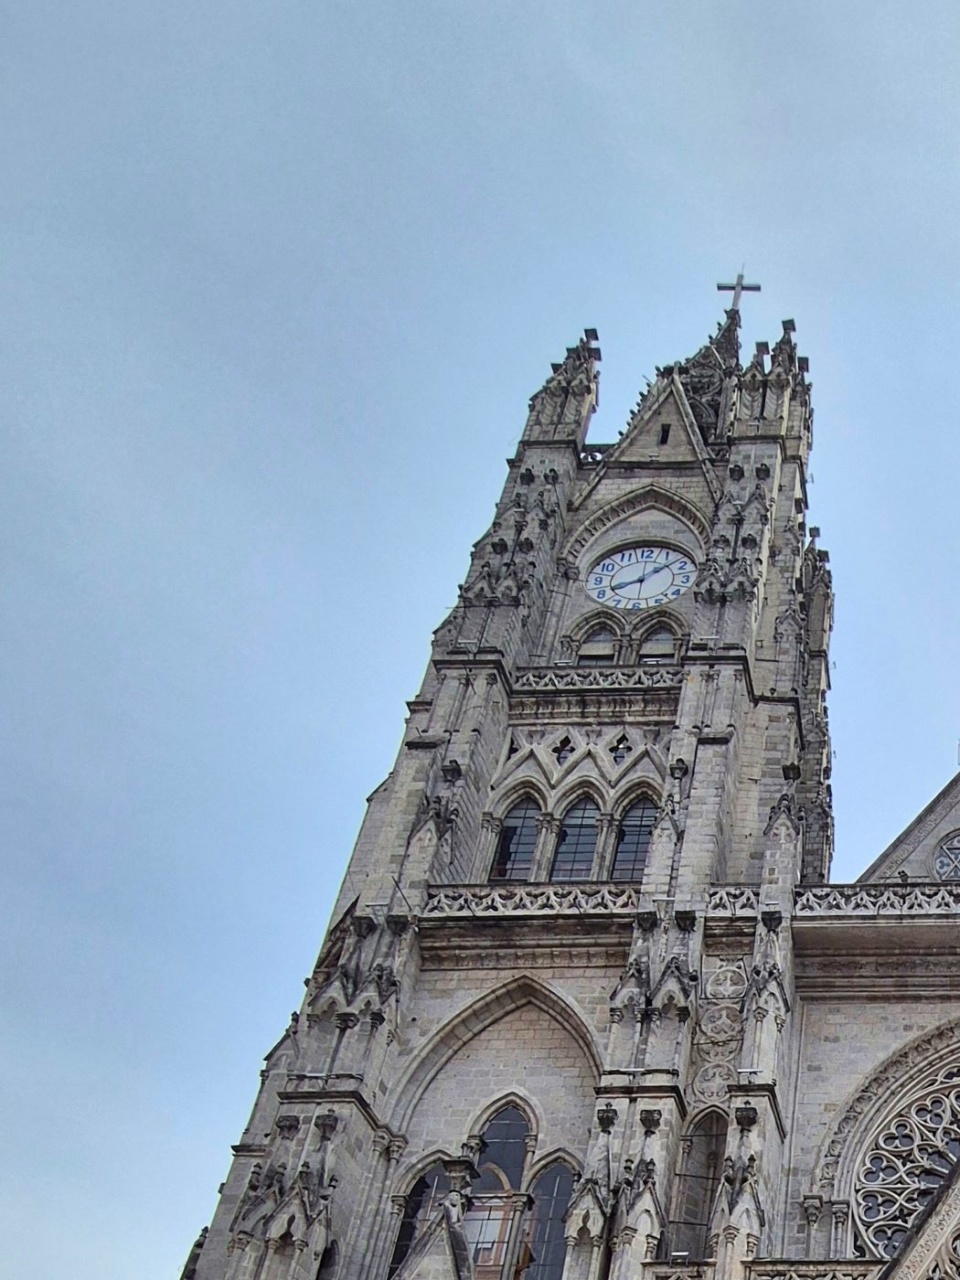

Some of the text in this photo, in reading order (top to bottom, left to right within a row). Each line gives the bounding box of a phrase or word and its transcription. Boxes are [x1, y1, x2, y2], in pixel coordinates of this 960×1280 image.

[621, 553, 632, 562] 11
[641, 550, 654, 559] 12
[602, 563, 614, 572] 10
[678, 561, 687, 570] 2
[594, 577, 602, 585] 9
[681, 575, 690, 584] 3
[597, 590, 606, 599] 8
[671, 589, 680, 599] 4
[632, 602, 641, 610] 6
